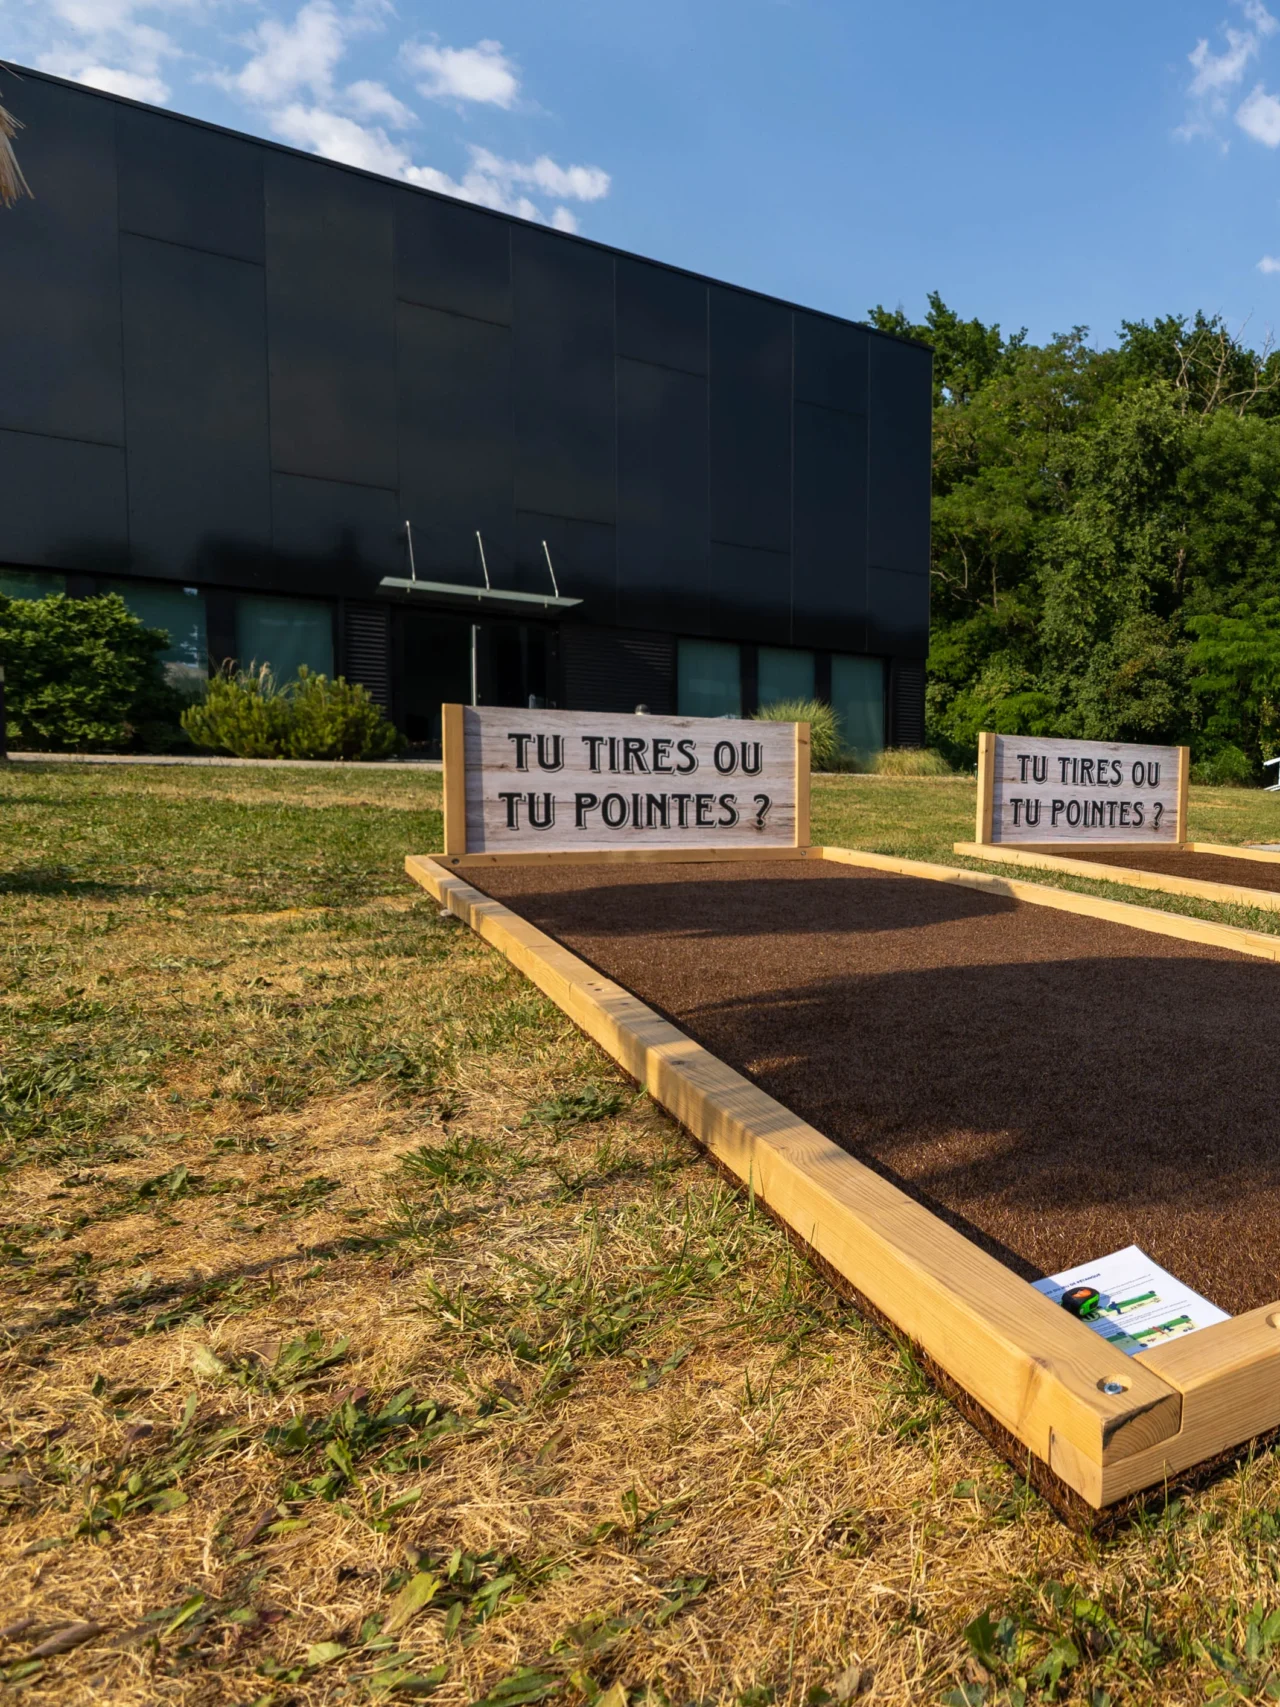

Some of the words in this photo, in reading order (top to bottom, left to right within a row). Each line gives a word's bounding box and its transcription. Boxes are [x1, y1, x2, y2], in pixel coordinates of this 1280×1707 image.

[507, 733, 564, 773] TU
[581, 735, 699, 775] TIRES
[713, 740, 763, 776] OU
[1016, 754, 1048, 784] TU
[1057, 757, 1123, 787] TIRES
[1131, 761, 1161, 788] OU
[498, 792, 555, 831] TU
[574, 792, 740, 830] POINTES
[754, 794, 773, 828] ?
[1010, 798, 1041, 827] TU
[1051, 799, 1145, 828] POINTES
[1153, 802, 1164, 828] ?
